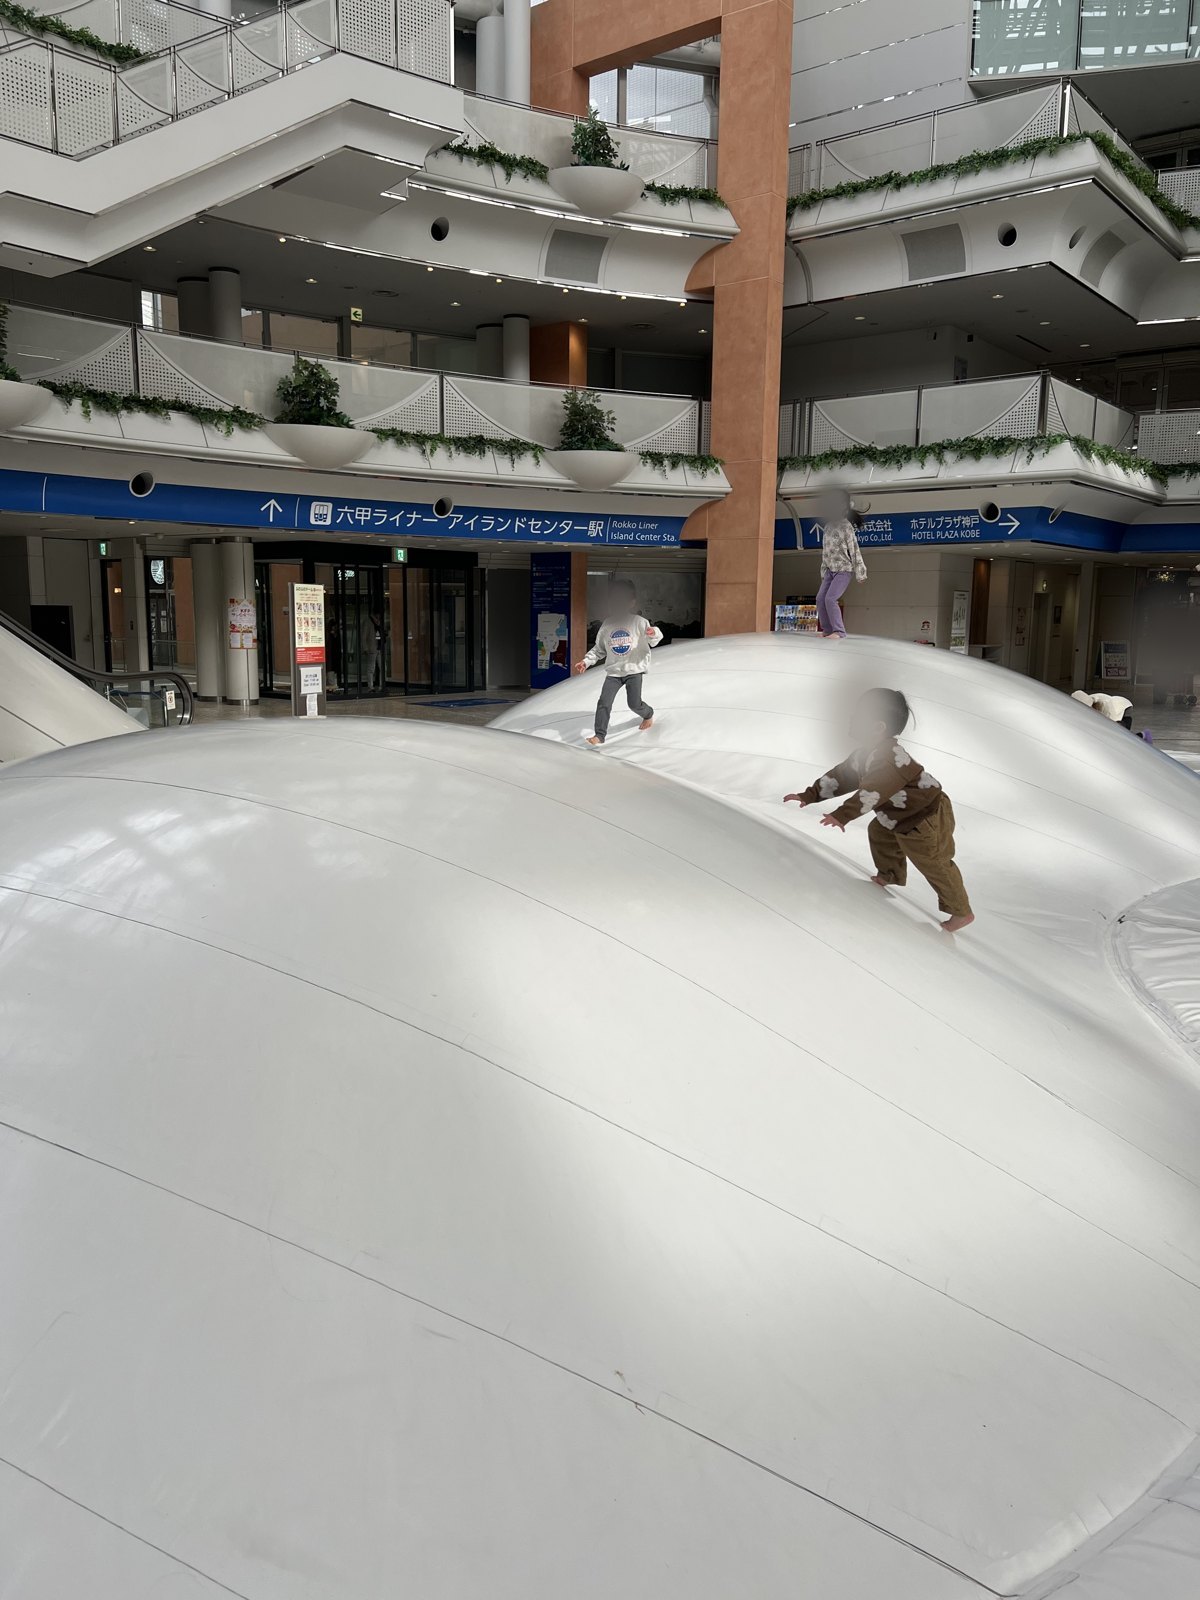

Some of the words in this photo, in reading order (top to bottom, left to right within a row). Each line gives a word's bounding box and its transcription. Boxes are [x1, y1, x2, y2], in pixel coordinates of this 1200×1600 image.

[336, 505, 439, 527] 六甲ライナー
[448, 514, 604, 537] アイランドセンター駅
[612, 520, 637, 530] Rokko
[638, 521, 659, 530] Liner
[910, 514, 980, 530] ホテルプラザ神戸
[610, 532, 634, 541] Island
[635, 533, 661, 541] Center
[662, 534, 677, 542] Sta.
[911, 530, 935, 540] HOTEL
[936, 530, 960, 539] PLAZA
[960, 529, 980, 538] KOBE
